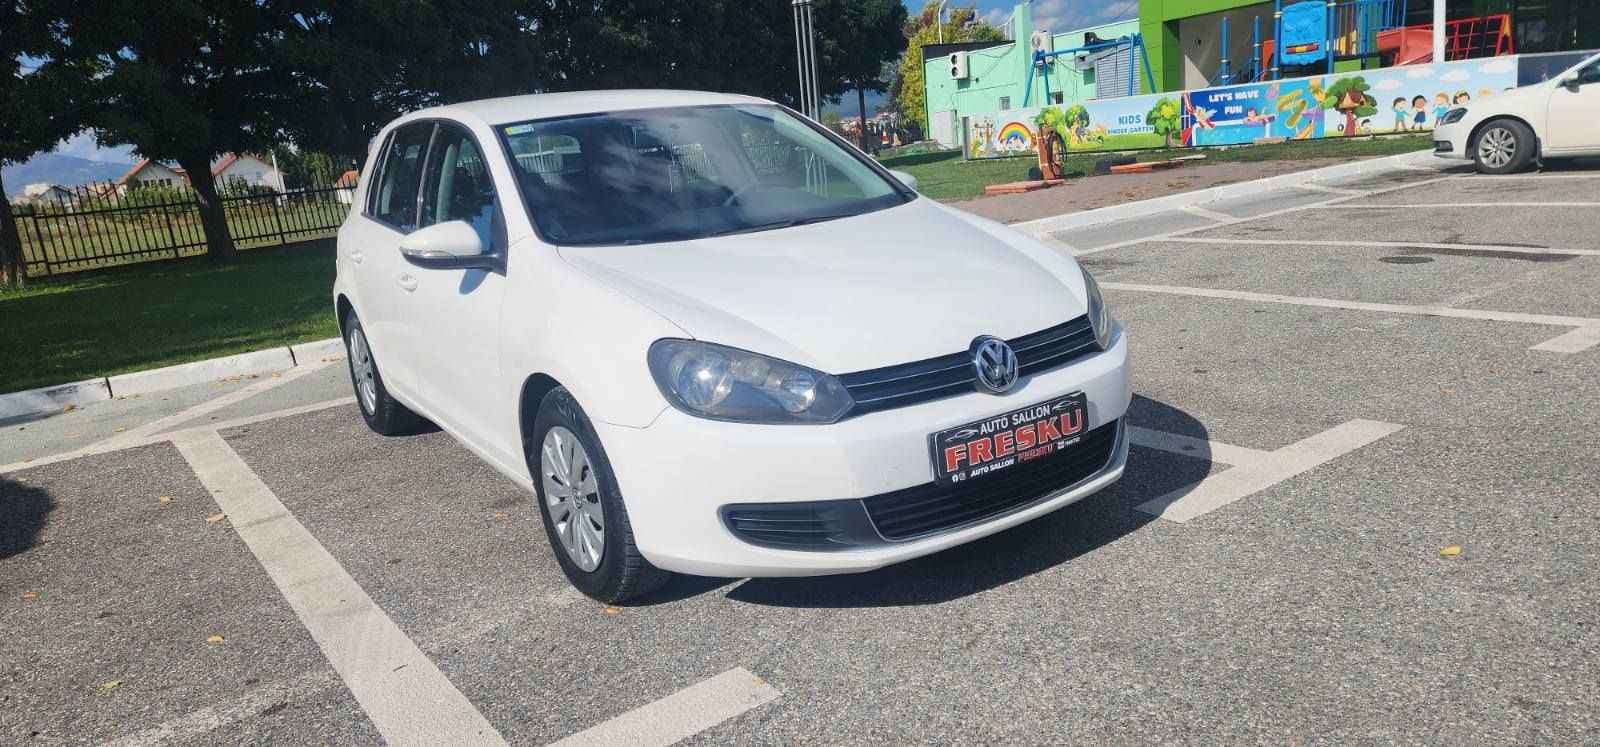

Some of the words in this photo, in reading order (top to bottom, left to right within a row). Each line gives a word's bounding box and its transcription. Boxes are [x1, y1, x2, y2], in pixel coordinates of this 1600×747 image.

[1209, 92, 1233, 103] LET'S
[1235, 90, 1259, 100] HAVE
[1225, 105, 1243, 115] FUN
[1118, 114, 1142, 125] KIDS
[980, 418, 1008, 435] AUTO
[1012, 405, 1051, 425] SALLON
[945, 408, 1083, 472] FRESKU
[970, 465, 989, 477] AUTO
[990, 456, 1015, 471] SALLON
